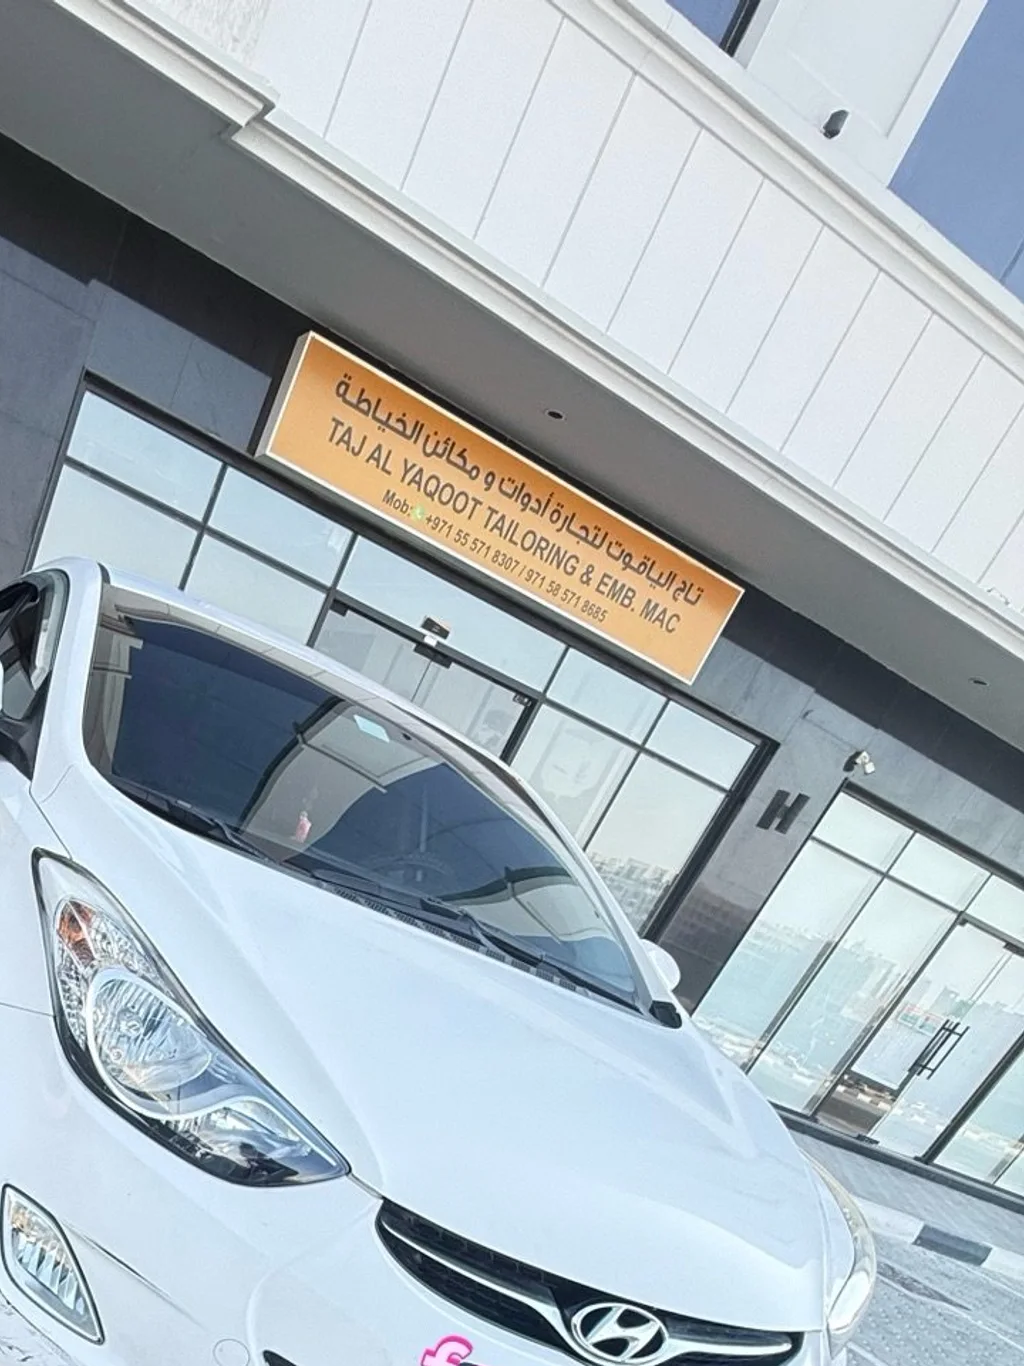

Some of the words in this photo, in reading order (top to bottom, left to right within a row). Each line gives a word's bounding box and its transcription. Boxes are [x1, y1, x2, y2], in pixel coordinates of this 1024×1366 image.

[335, 372, 425, 445] الخياطة
[422, 431, 481, 481] مكائن
[483, 470, 496, 491] و
[498, 476, 555, 517] أدوات
[328, 417, 368, 457] TAJ
[365, 443, 392, 476] AL
[399, 457, 484, 520] YAQOOT
[483, 506, 580, 577] TAILORING
[579, 564, 596, 587] &
[595, 572, 636, 612] EMB.
[639, 599, 681, 634] MAC
[549, 502, 609, 550] لتجارة
[382, 488, 413, 517] Mob:
[425, 513, 454, 538] +971
[453, 531, 468, 547] 55
[469, 537, 491, 557] 571
[491, 547, 520, 573] 8307
[525, 568, 546, 588] 971
[546, 580, 560, 597] 58
[560, 586, 582, 607] 571
[581, 599, 609, 625] 8685
[606, 540, 677, 592] الياقوت
[672, 580, 704, 606] تاج
